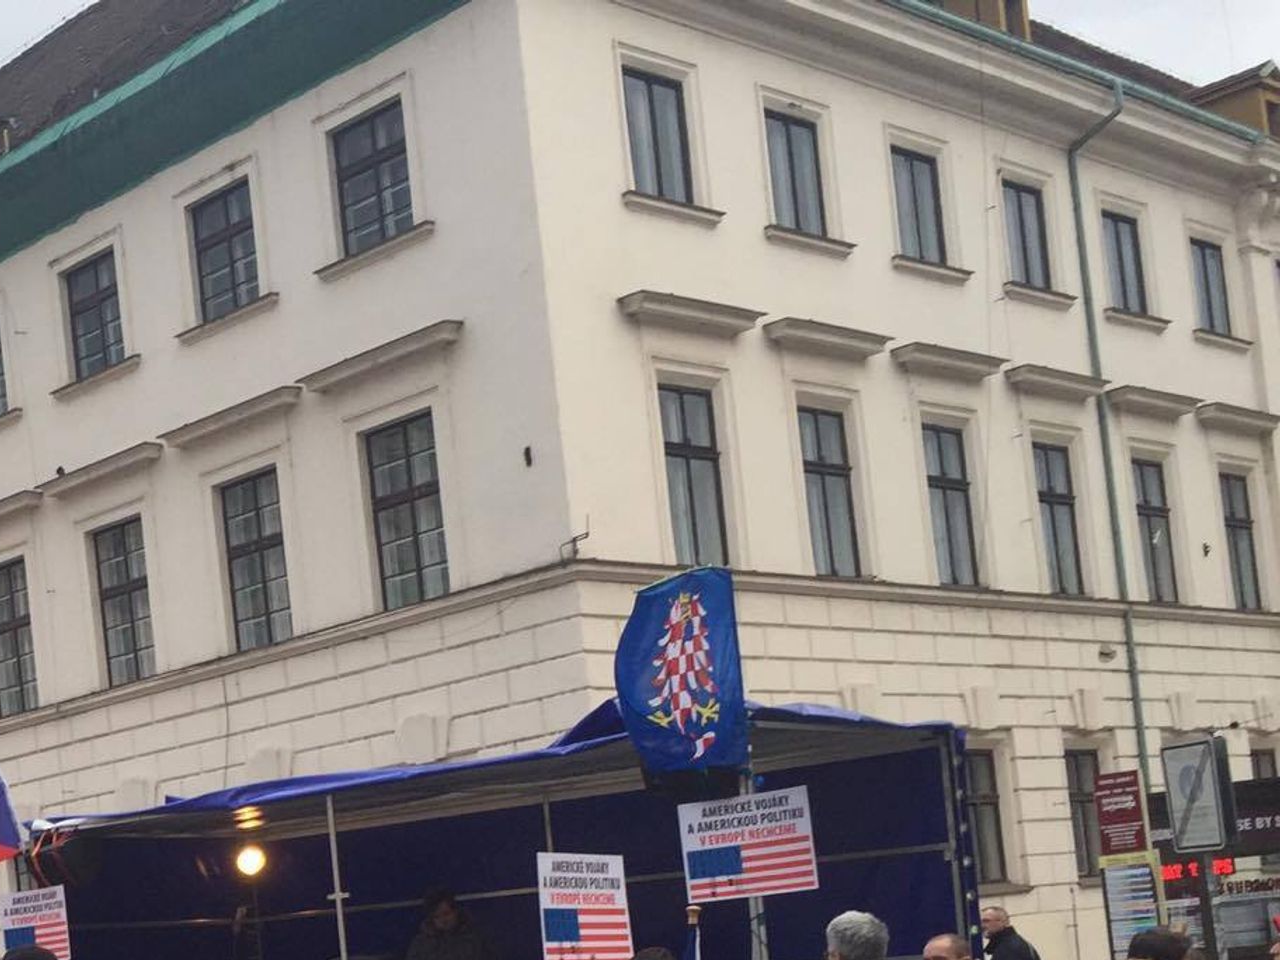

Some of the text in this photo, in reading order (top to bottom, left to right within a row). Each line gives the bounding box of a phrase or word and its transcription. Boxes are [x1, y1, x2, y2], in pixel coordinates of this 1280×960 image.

[687, 807, 804, 834] A AMERICKOU POLITIKU
